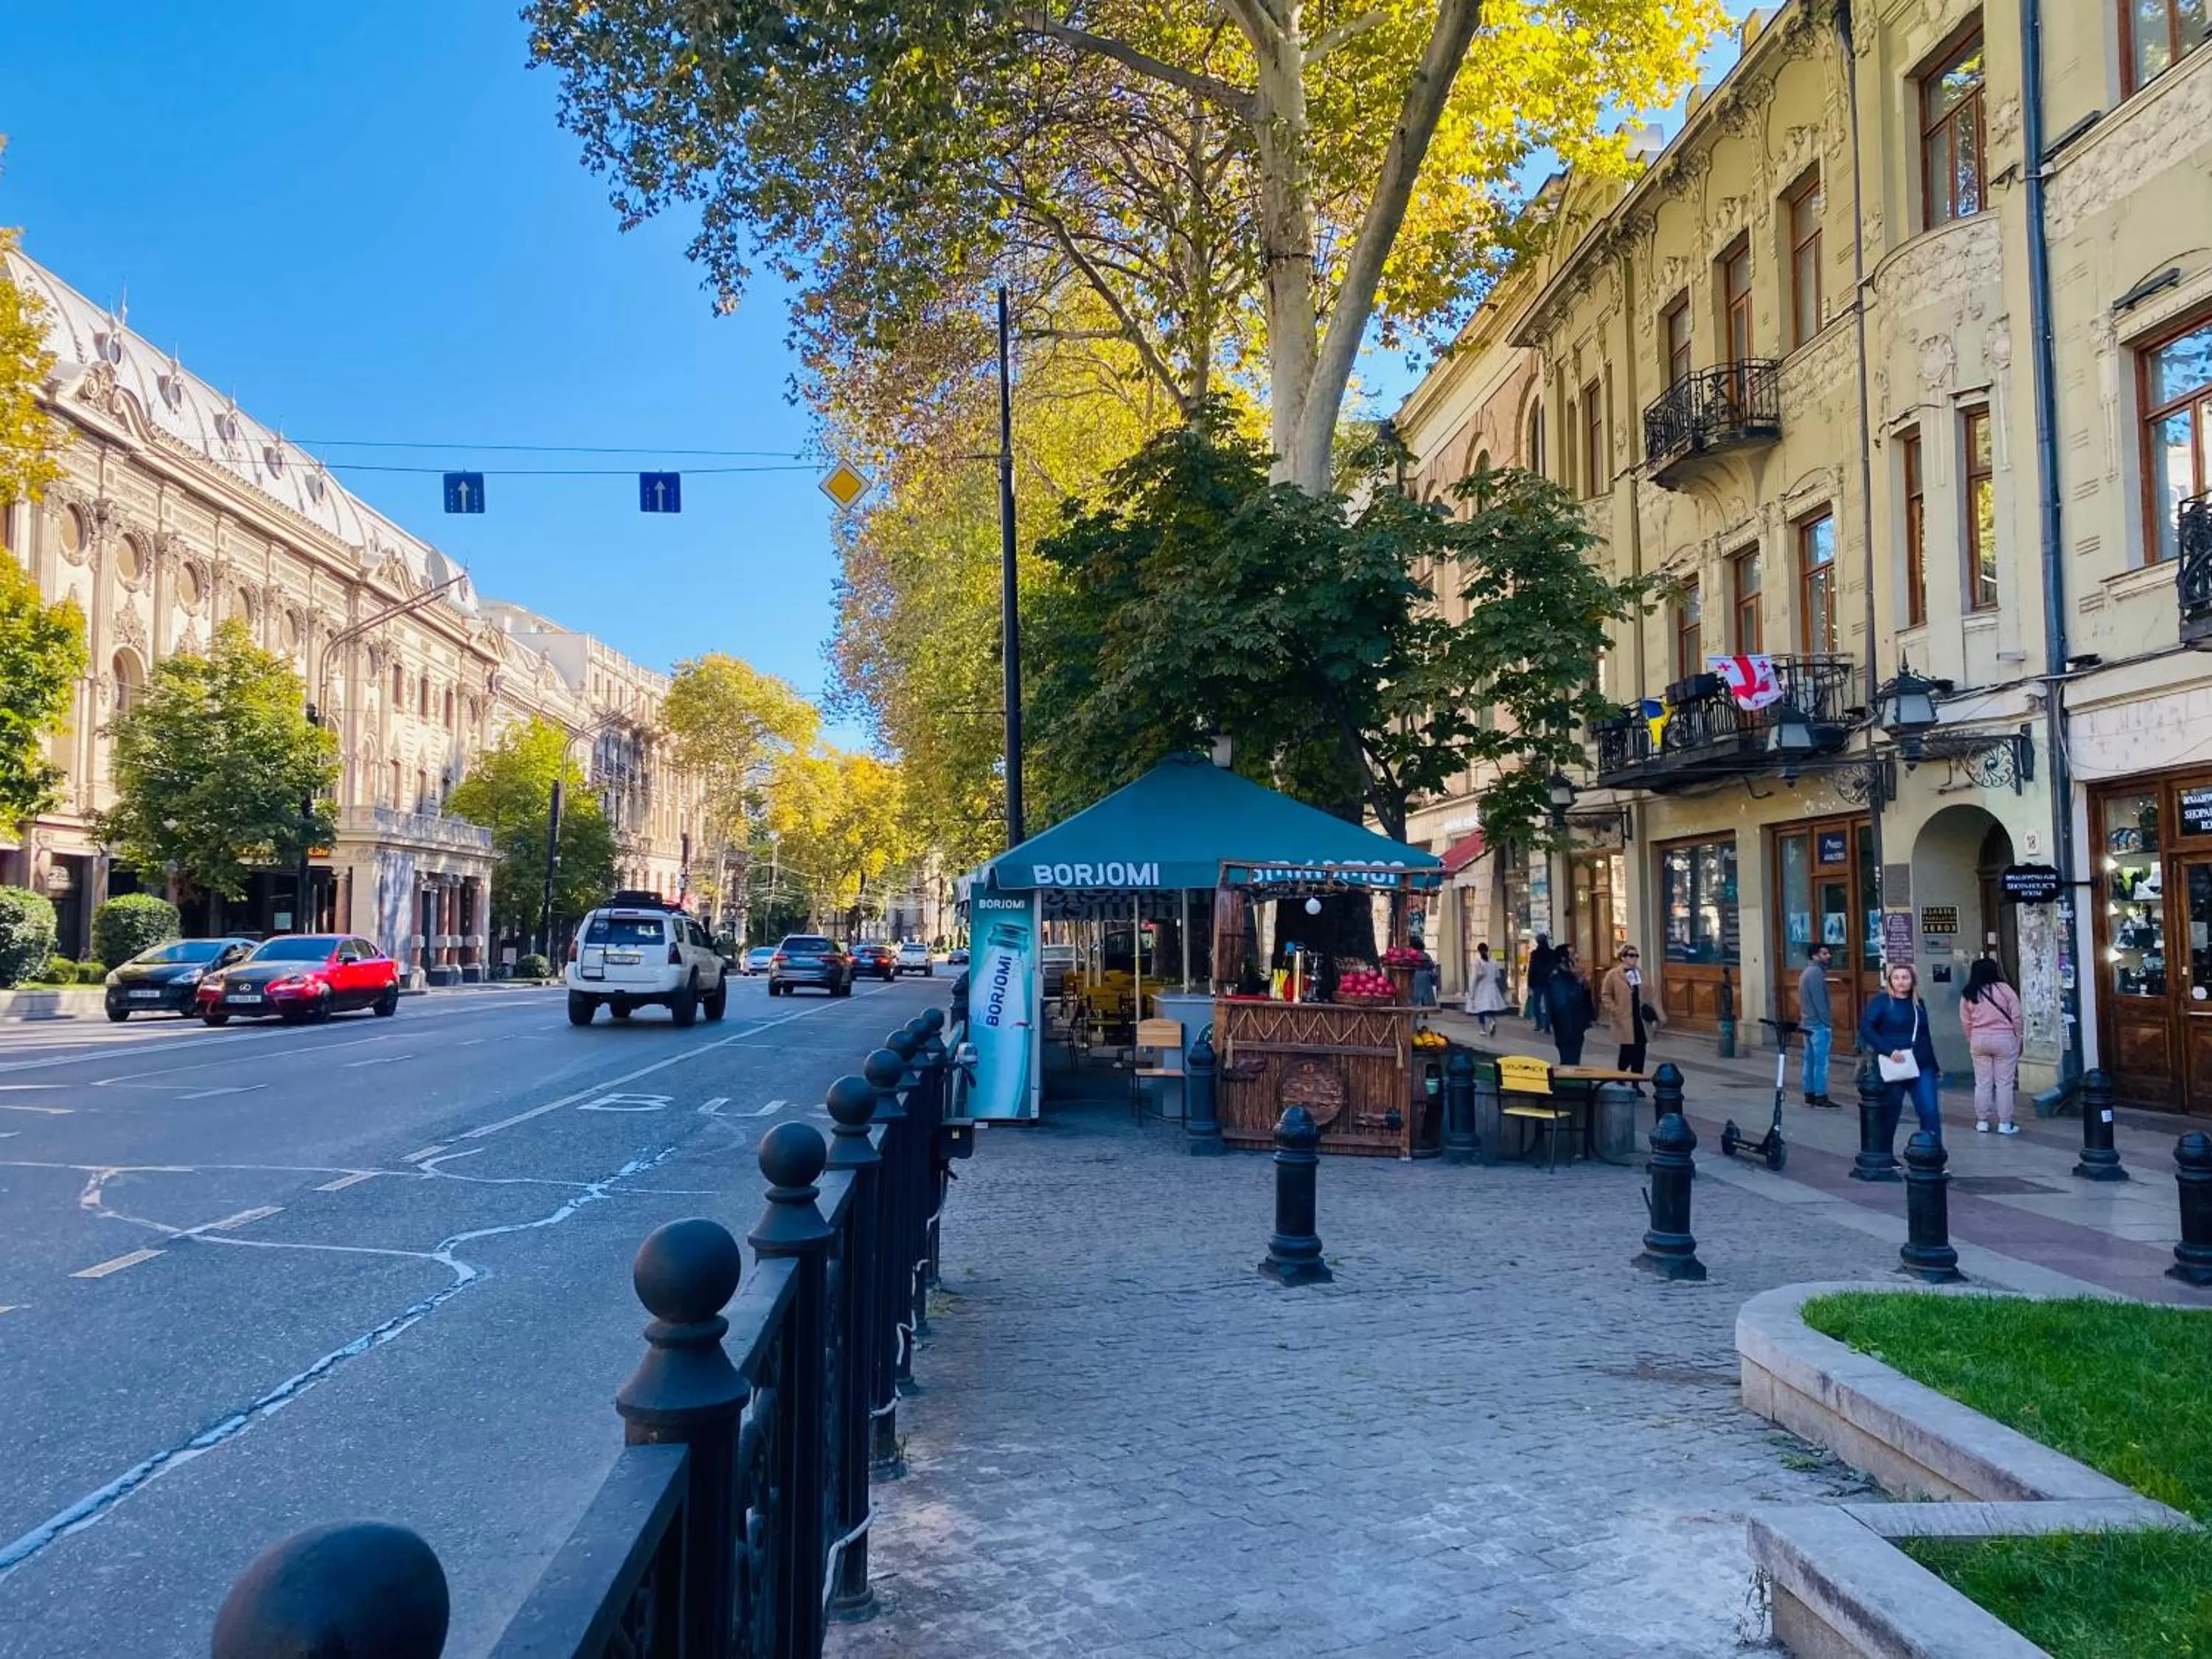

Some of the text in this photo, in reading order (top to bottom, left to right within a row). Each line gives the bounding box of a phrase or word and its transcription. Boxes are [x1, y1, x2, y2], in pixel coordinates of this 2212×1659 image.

[1032, 862, 1160, 886] BORJOMI
[978, 899, 1026, 909] BORJOMI
[985, 955, 1012, 1026] BORJOMI
[575, 1093, 832, 1119] BU
